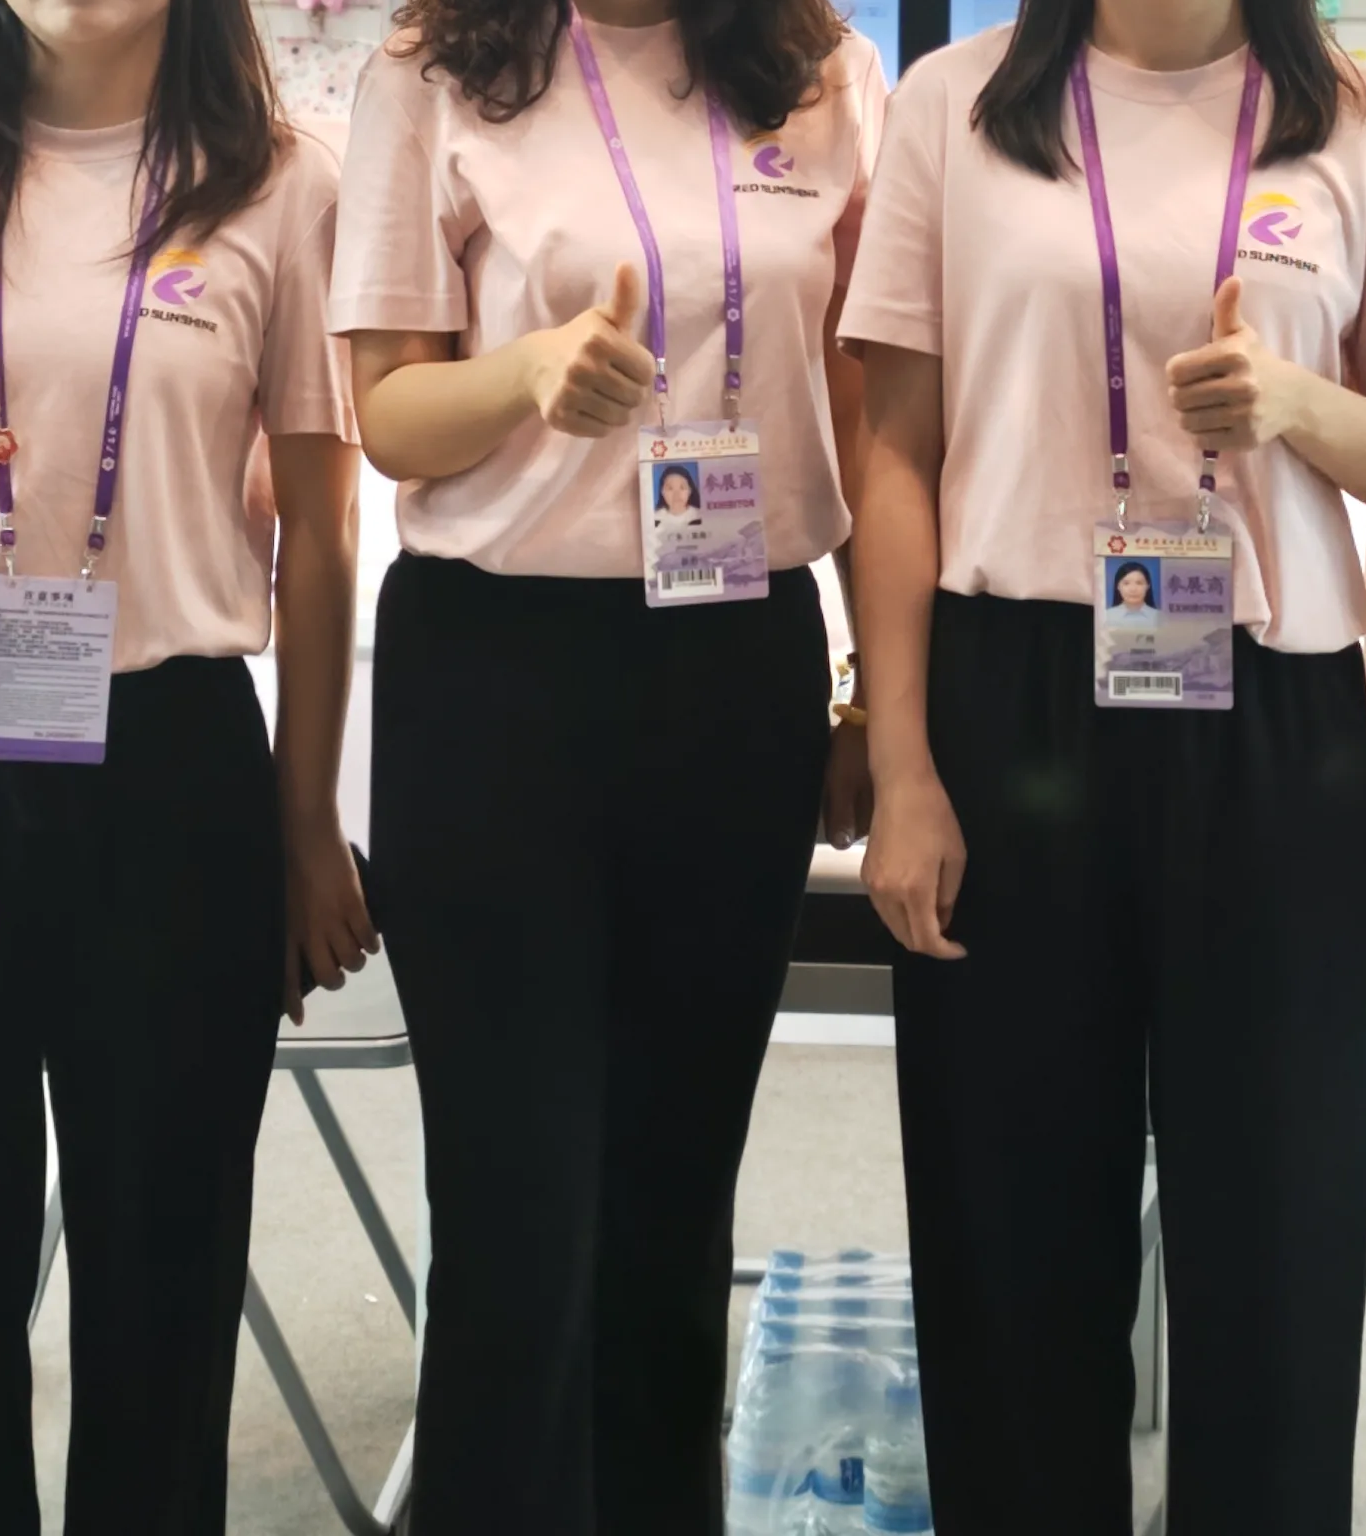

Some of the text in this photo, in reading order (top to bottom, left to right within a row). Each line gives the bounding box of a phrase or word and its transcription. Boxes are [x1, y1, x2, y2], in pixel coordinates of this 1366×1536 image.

[705, 472, 754, 492] 参展商
[1167, 575, 1225, 596] 参展商
